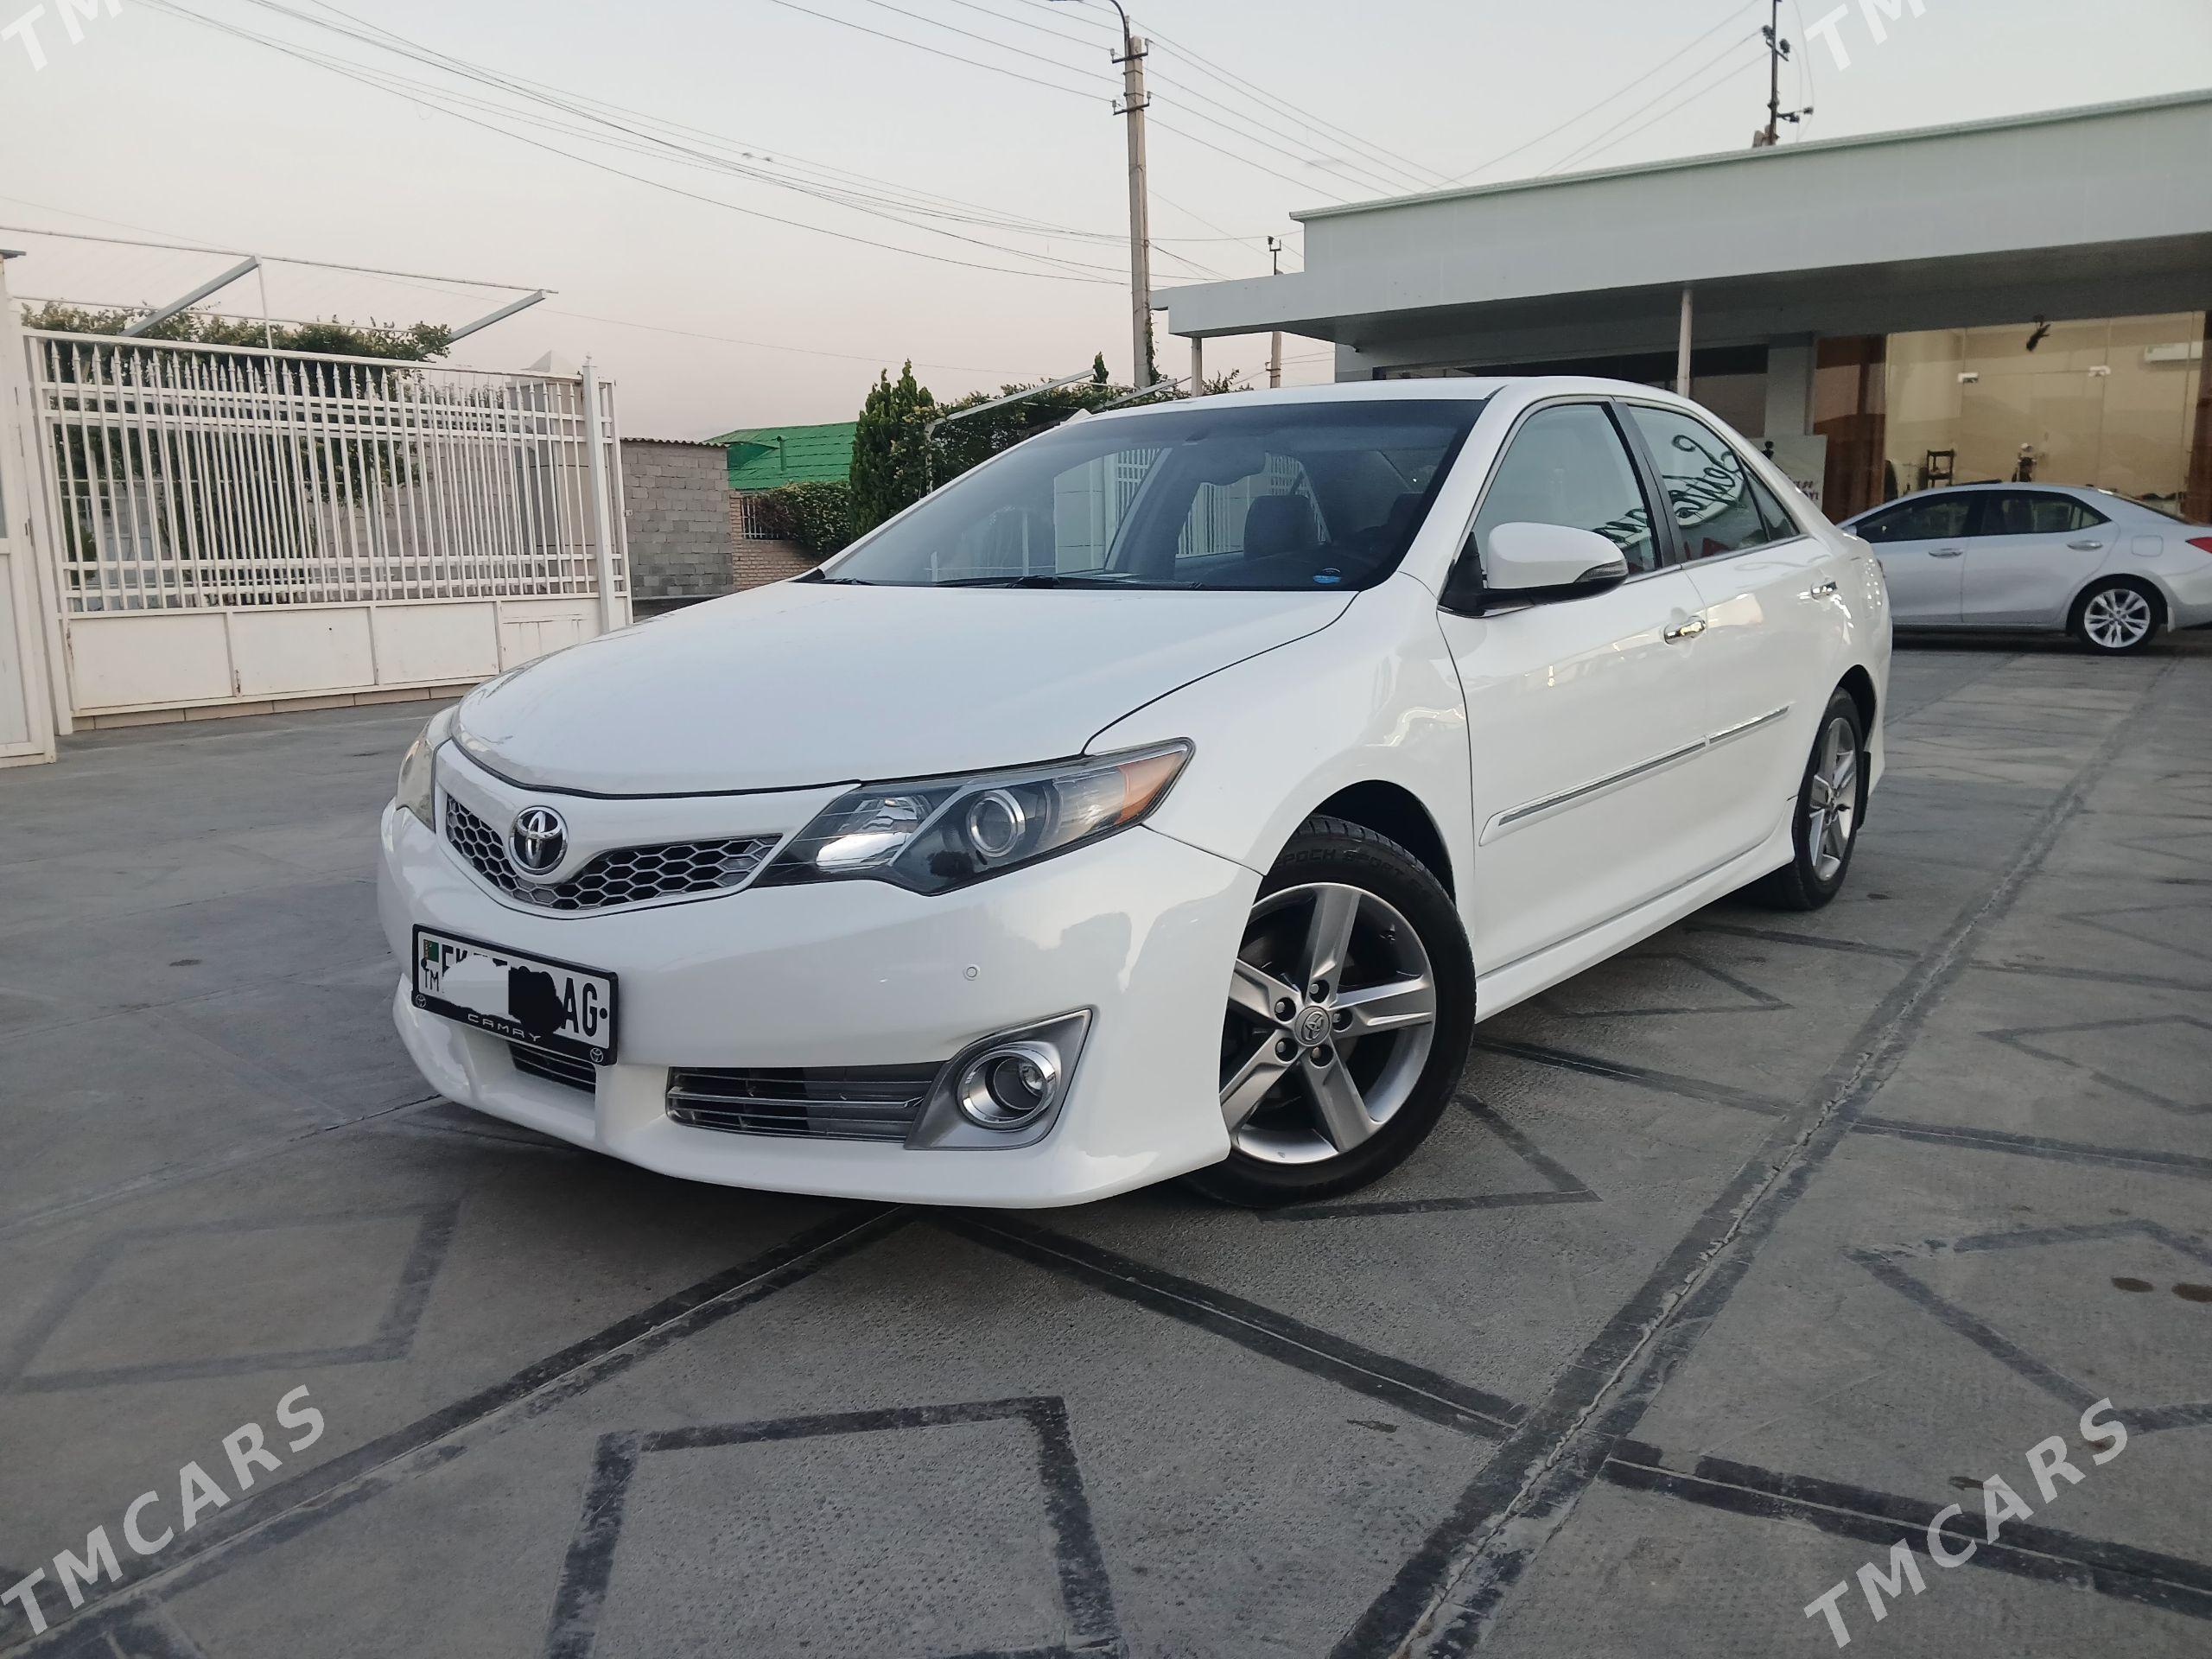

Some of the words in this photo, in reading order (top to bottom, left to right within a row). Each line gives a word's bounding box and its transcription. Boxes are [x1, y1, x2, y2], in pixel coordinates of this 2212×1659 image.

[424, 967, 440, 992] TM
[561, 977, 598, 1037] AG
[467, 1014, 541, 1042] CAMRY
